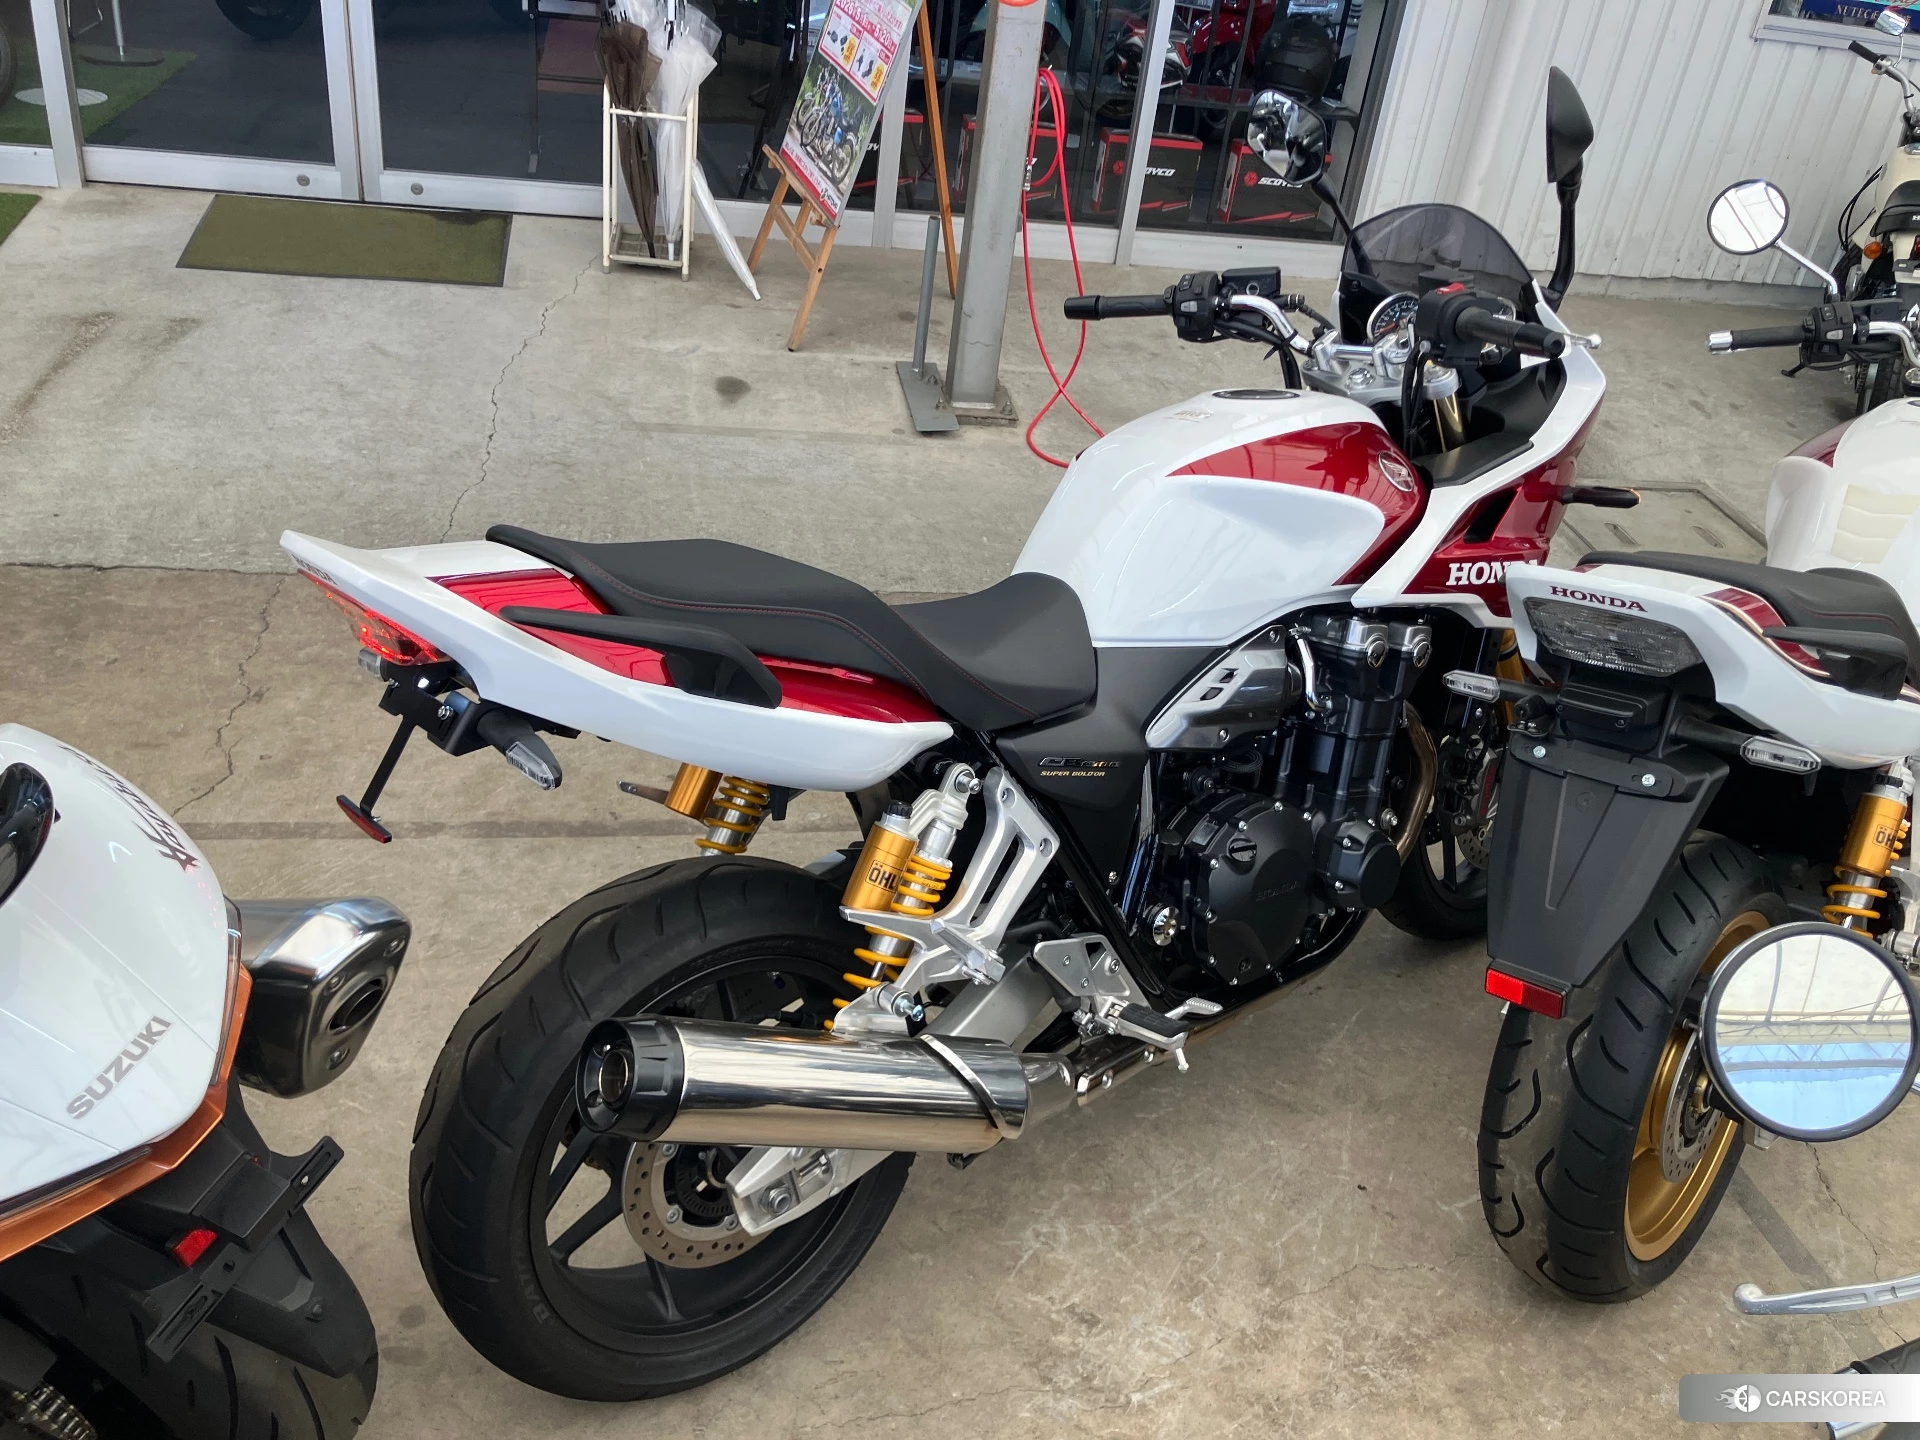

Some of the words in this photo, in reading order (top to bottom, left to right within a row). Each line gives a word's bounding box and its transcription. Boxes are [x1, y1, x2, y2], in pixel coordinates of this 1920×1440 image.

[1145, 167, 1176, 177] OYCO
[1258, 177, 1303, 188] SCOY
[1446, 559, 1538, 586] HON
[1549, 585, 1648, 613] HONDA
[66, 1016, 172, 1120] SUZUKI
